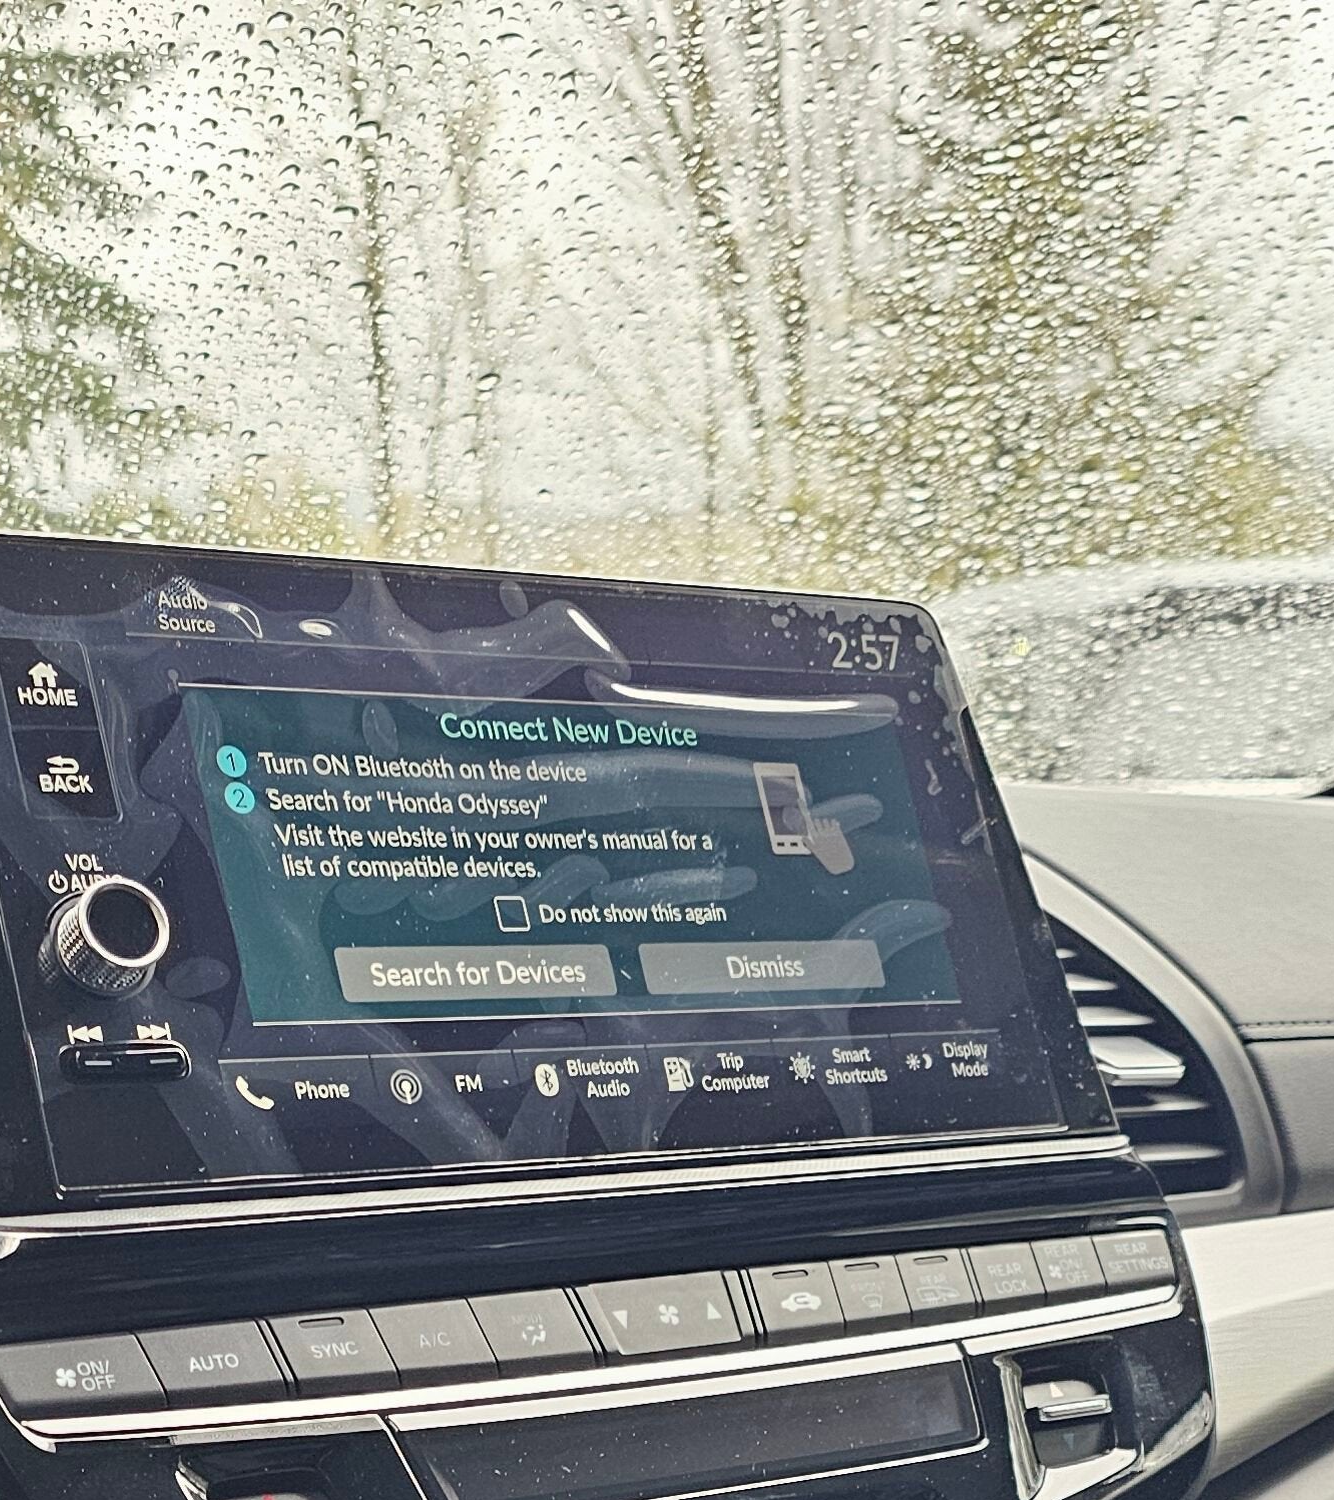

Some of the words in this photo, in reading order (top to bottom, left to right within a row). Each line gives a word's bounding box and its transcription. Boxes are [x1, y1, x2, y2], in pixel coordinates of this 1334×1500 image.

[157, 590, 208, 612] Audio
[158, 613, 216, 634] Source
[827, 630, 900, 671] 2:57
[18, 687, 78, 708] HOME
[440, 712, 548, 742] Connect
[553, 716, 609, 744] New
[616, 719, 698, 746] Device
[258, 751, 308, 775] Turn
[313, 754, 350, 777] ON
[355, 755, 455, 780] Bluetooth
[459, 762, 485, 780] on
[488, 759, 521, 781] the
[526, 760, 587, 782] device
[39, 774, 94, 794] BACK
[266, 788, 339, 812] Search
[343, 790, 372, 812] for
[377, 790, 453, 814] "Honda
[458, 793, 548, 819] Odyssey"
[274, 823, 324, 848] Visit
[328, 825, 364, 849] the
[367, 826, 447, 848] website
[451, 826, 471, 848] in
[474, 830, 519, 853] your
[525, 829, 598, 850] owner's
[602, 830, 668, 850] manual
[670, 829, 697, 850] for
[701, 835, 713, 850] a
[64, 853, 104, 872] VOL
[282, 854, 315, 878] list
[320, 855, 343, 878] of
[347, 855, 459, 881] compatible
[463, 856, 542, 878] devices.
[538, 903, 566, 923] Do
[571, 905, 601, 923] not
[603, 903, 649, 923] show
[651, 903, 682, 922] this
[685, 903, 727, 926] again
[370, 961, 451, 988] Search
[455, 960, 491, 985] for
[496, 960, 586, 985] Devices
[726, 955, 805, 980] Dismiss
[832, 1047, 871, 1064] Smart
[942, 1041, 988, 1061] Display
[566, 1056, 639, 1078] Bluetooth
[717, 1052, 743, 1072] Trip
[951, 1062, 989, 1078] Mode
[455, 1074, 483, 1093] FM
[701, 1073, 770, 1094] Computer
[826, 1066, 888, 1085] Shortcuts
[294, 1080, 350, 1101] Phone
[587, 1080, 630, 1098] Audio
[1044, 1243, 1080, 1258] REAR
[1115, 1240, 1149, 1256] REAR
[987, 1262, 1022, 1277] REAR
[1108, 1256, 1168, 1274] SETTINGS
[995, 1280, 1029, 1295] LOCK
[311, 1339, 359, 1360] SYNC
[419, 1332, 451, 1349] A/C
[77, 1359, 111, 1379] ON/
[188, 1352, 240, 1372] AUTO
[81, 1373, 116, 1392] OFF
